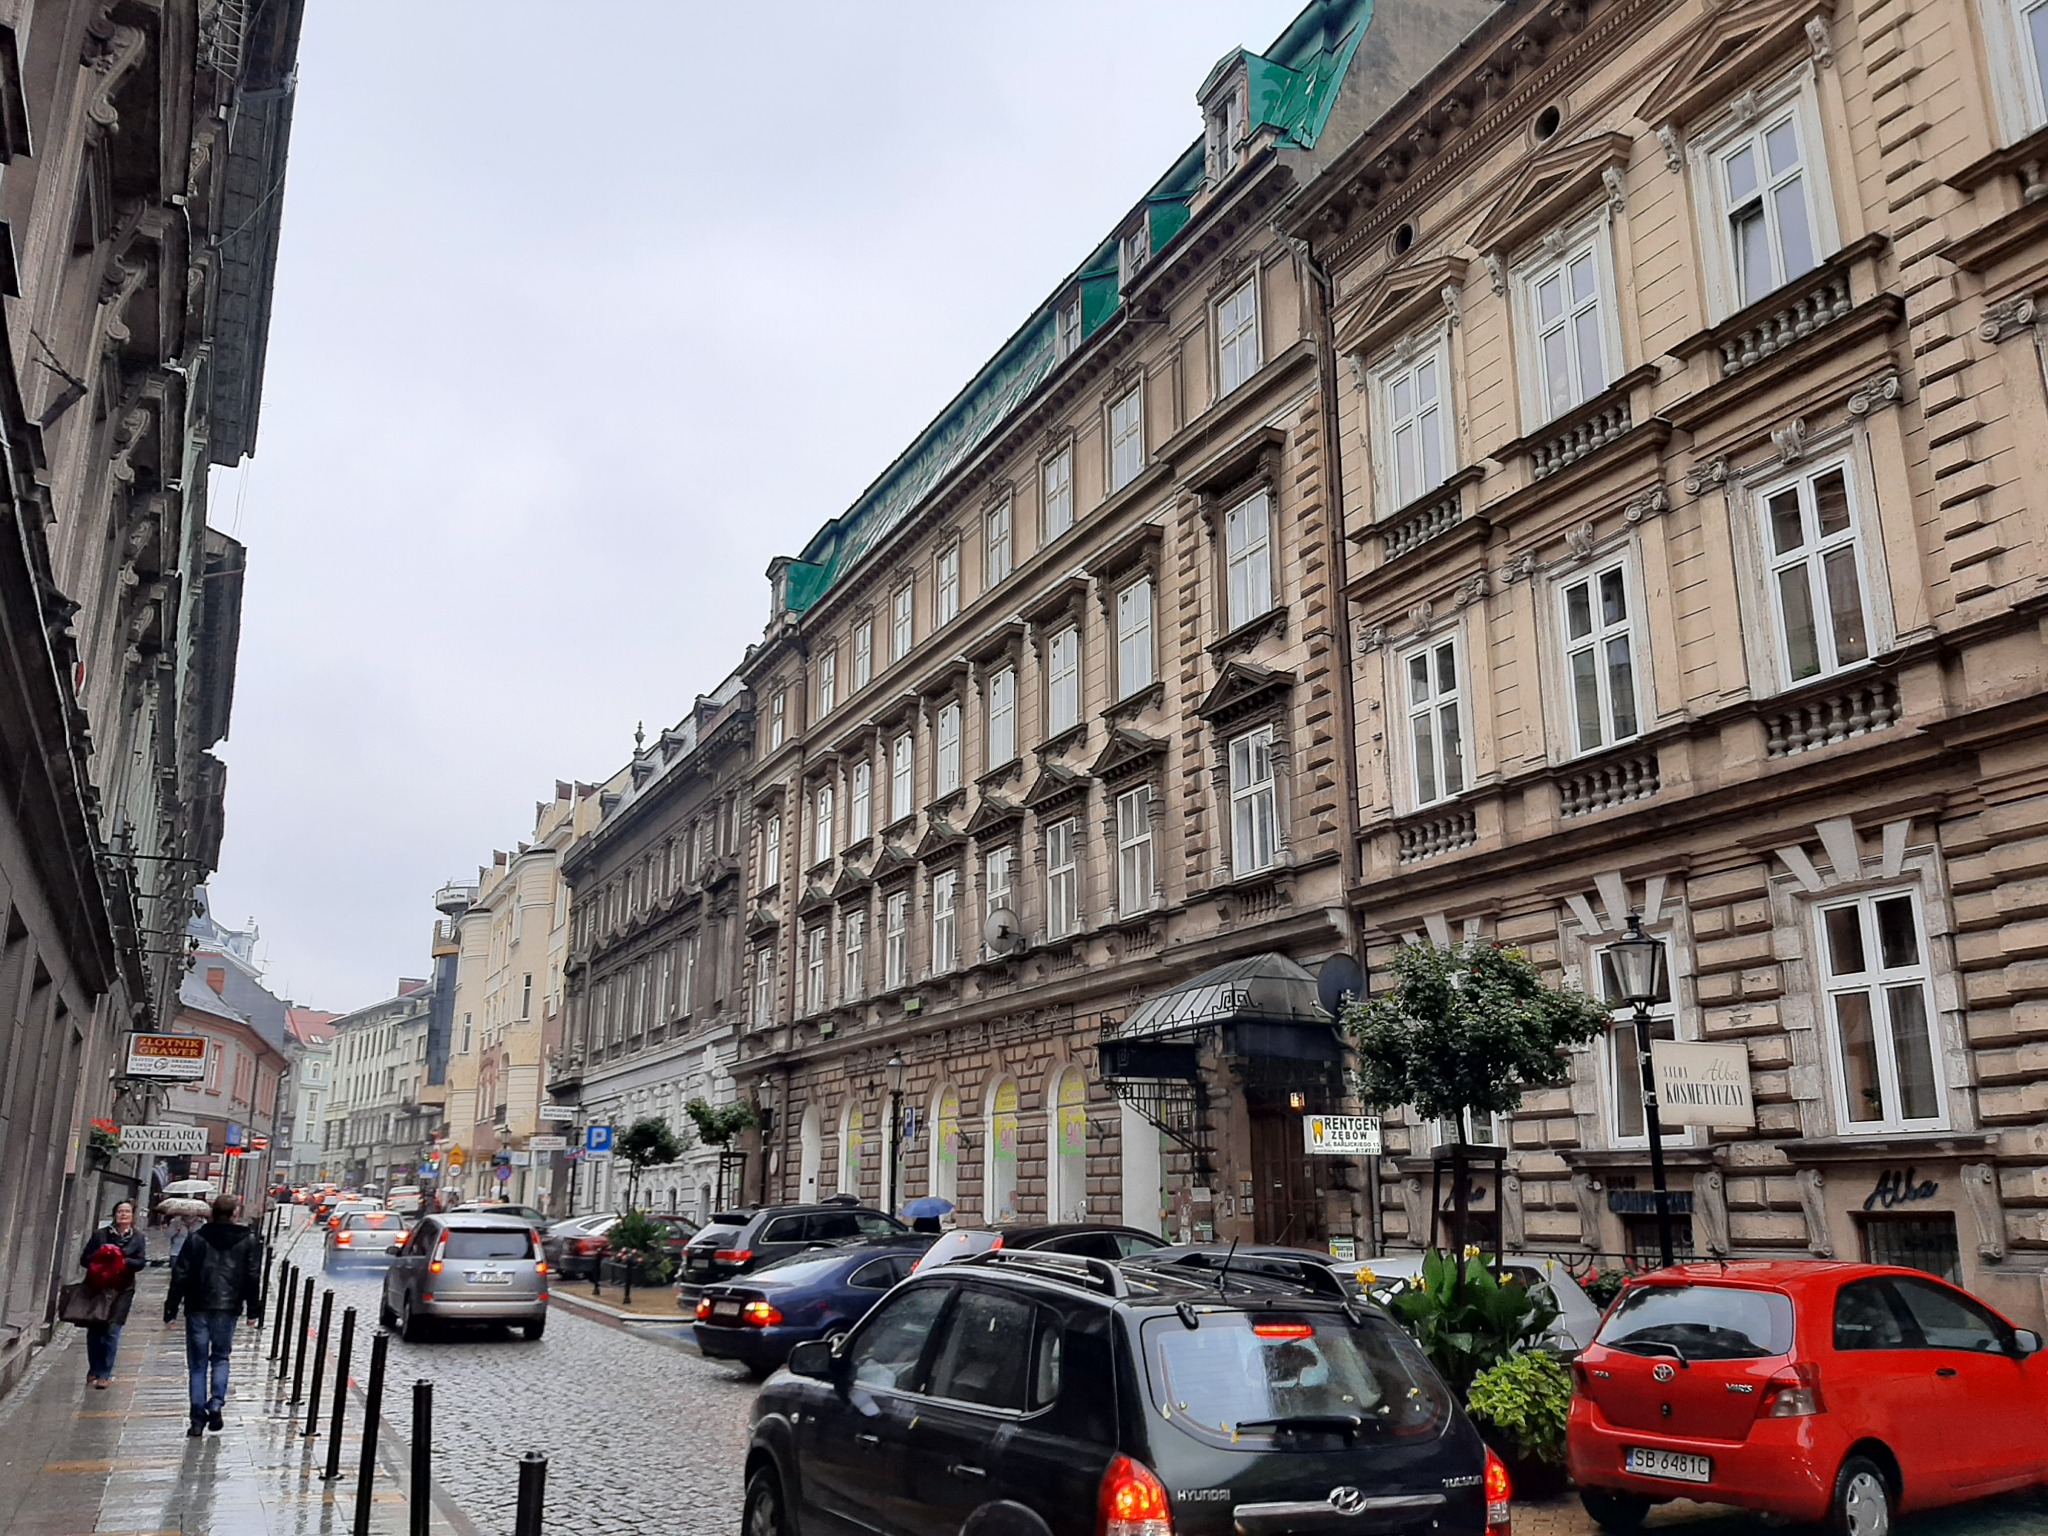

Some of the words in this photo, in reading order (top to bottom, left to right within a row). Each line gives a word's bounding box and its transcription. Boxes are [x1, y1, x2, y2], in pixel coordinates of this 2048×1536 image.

[138, 1046, 199, 1056] GRAWER
[1701, 1058, 1741, 1082] Alba
[1665, 1082, 1744, 1106] KOSMETYCZNY
[1324, 1117, 1378, 1131] RENTGEN
[124, 1128, 203, 1140] KANCELARIA
[591, 1127, 607, 1148] P
[1331, 1130, 1368, 1142] ZĘBÓW
[122, 1140, 203, 1152] NOTARIALNA
[1863, 1166, 1939, 1211] Alba
[1635, 1449, 1656, 1469] SB
[1660, 1453, 1707, 1475] 6481C
[1441, 1475, 1483, 1489] TUCSON
[1177, 1489, 1231, 1501] HYUNDAI
